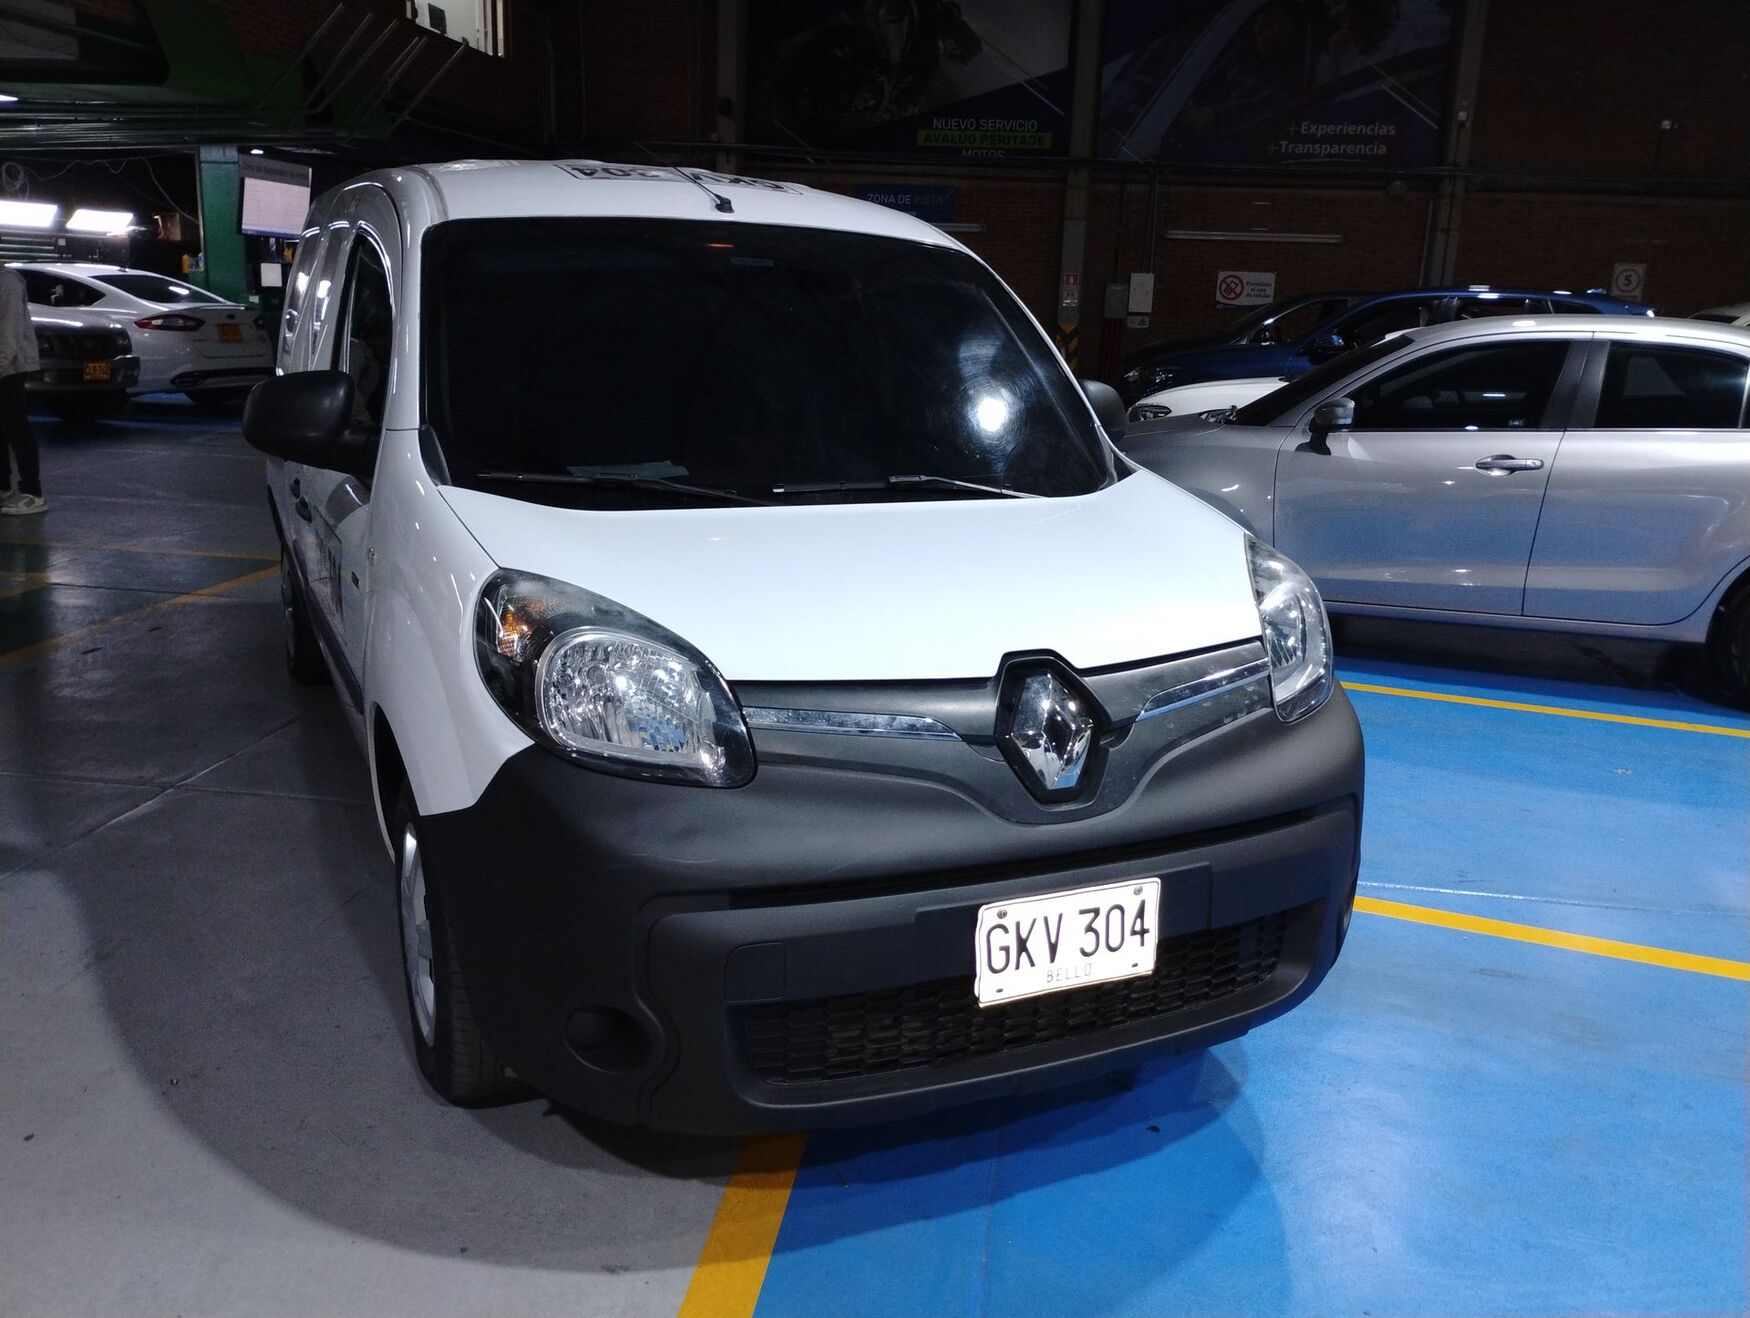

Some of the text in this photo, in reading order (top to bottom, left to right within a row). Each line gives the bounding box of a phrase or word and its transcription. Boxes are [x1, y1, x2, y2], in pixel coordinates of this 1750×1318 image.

[932, 118, 1039, 132] NUEVO SERVICIO
[980, 134, 1047, 147] PERITAJE
[867, 192, 896, 204] ZONA
[897, 194, 912, 205] DE
[1623, 274, 1633, 287] 5
[986, 898, 1150, 975] GKV 304
[1046, 962, 1093, 984] BELLO
